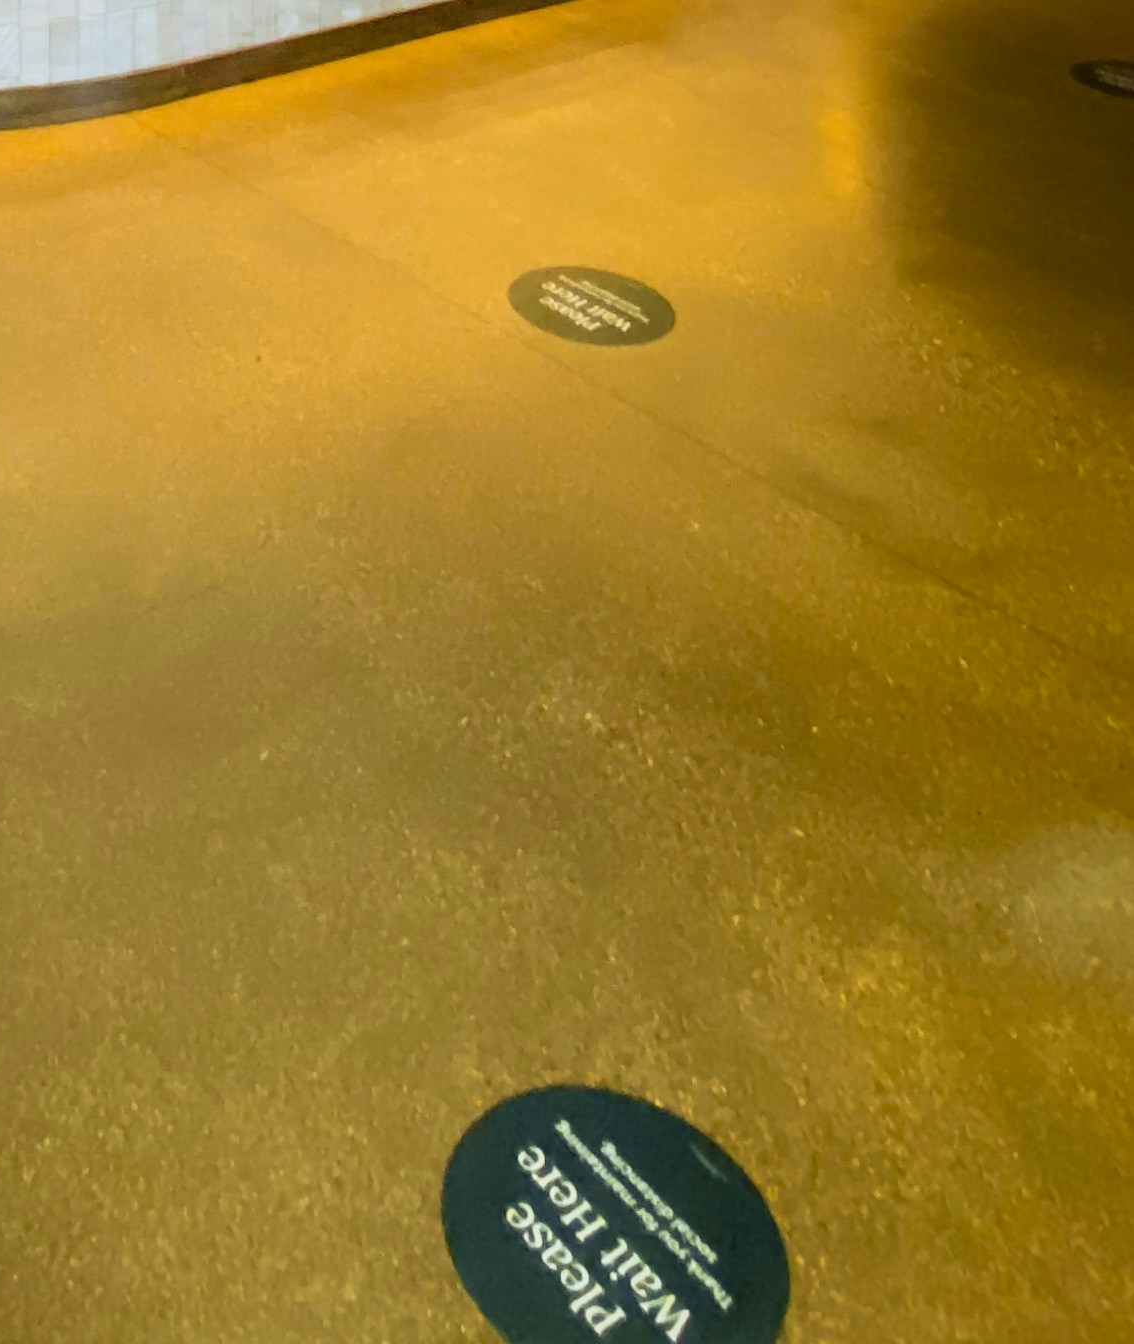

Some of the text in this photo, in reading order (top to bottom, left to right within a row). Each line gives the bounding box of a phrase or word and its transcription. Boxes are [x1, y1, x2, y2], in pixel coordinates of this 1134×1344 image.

[505, 1202, 626, 1337] Please
[516, 1145, 691, 1344] Wait Here
[555, 1118, 734, 1311] Thank you for maintaining
[669, 1218, 718, 1264] social
